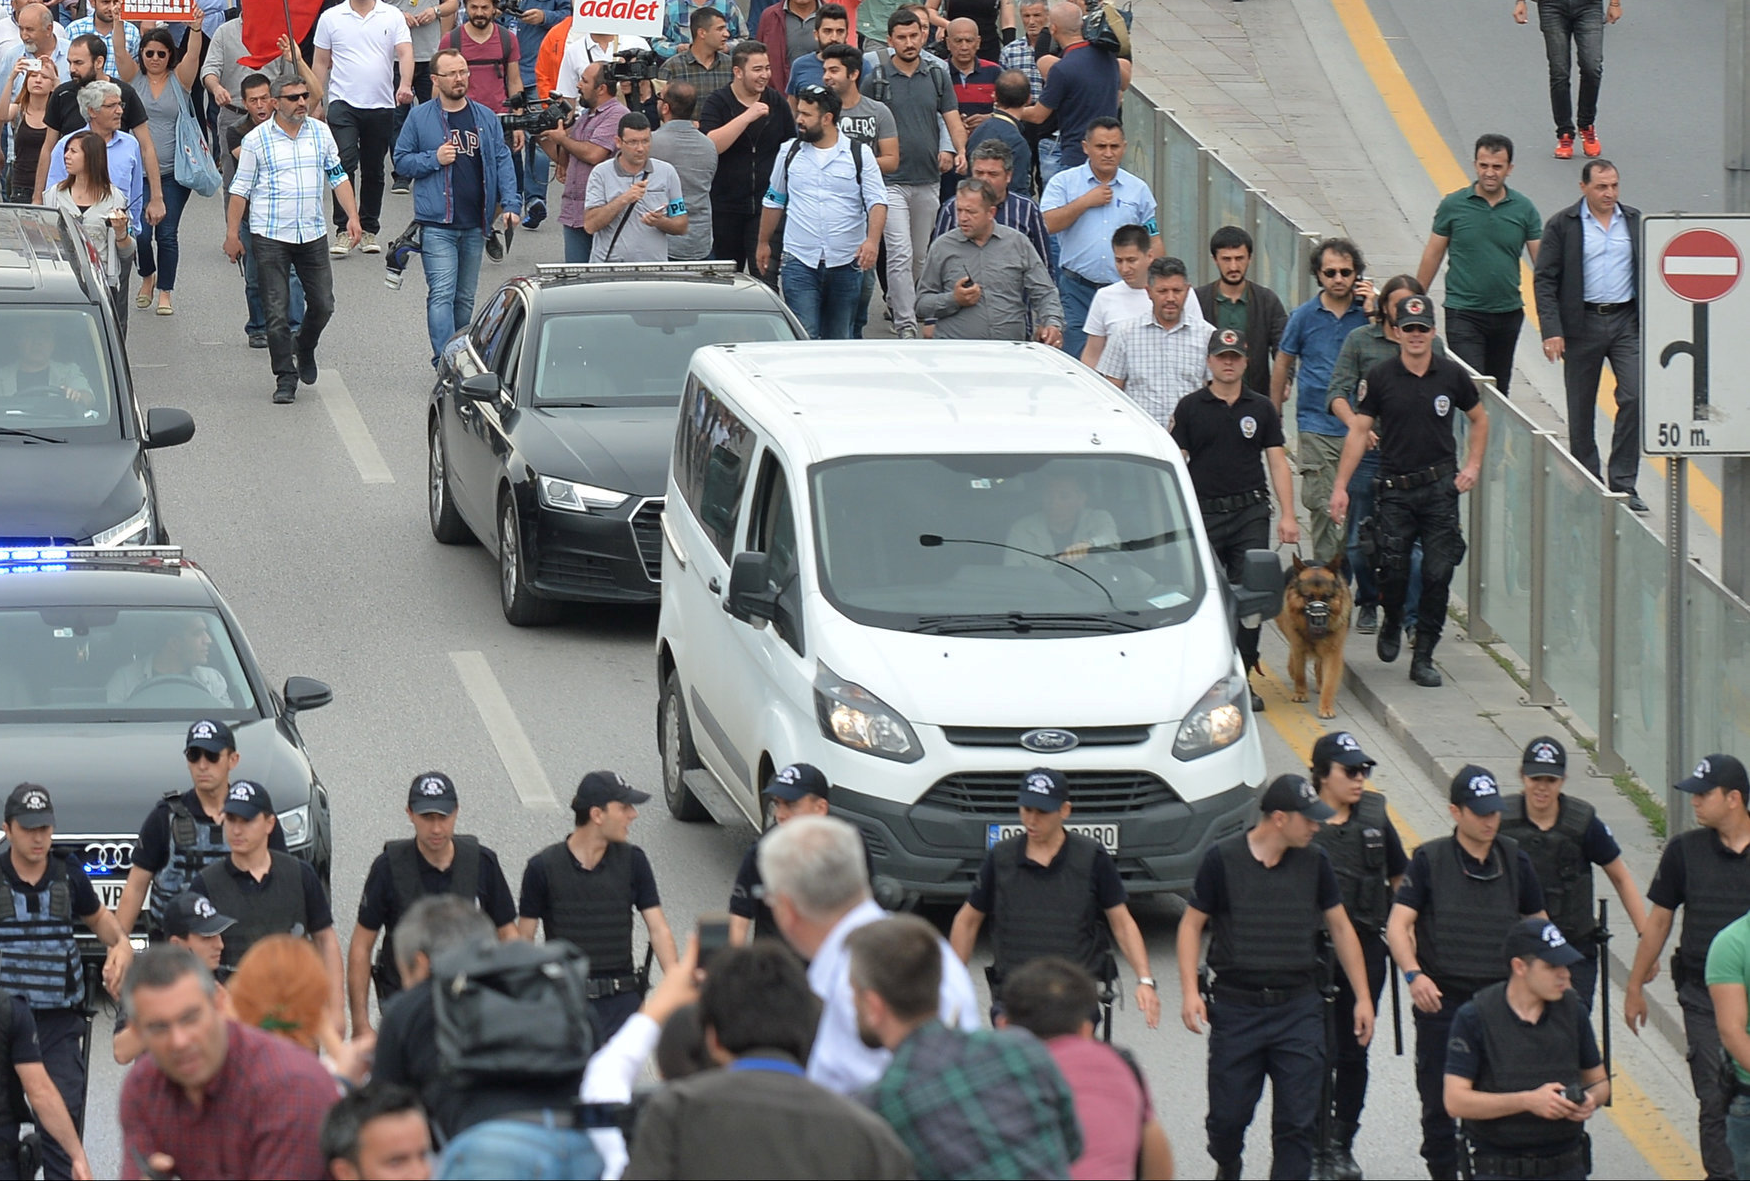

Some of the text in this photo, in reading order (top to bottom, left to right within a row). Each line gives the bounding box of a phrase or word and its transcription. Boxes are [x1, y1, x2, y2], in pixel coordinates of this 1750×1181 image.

[1658, 423, 1710, 447] 50 m.
[1034, 733, 1065, 746] Ford
